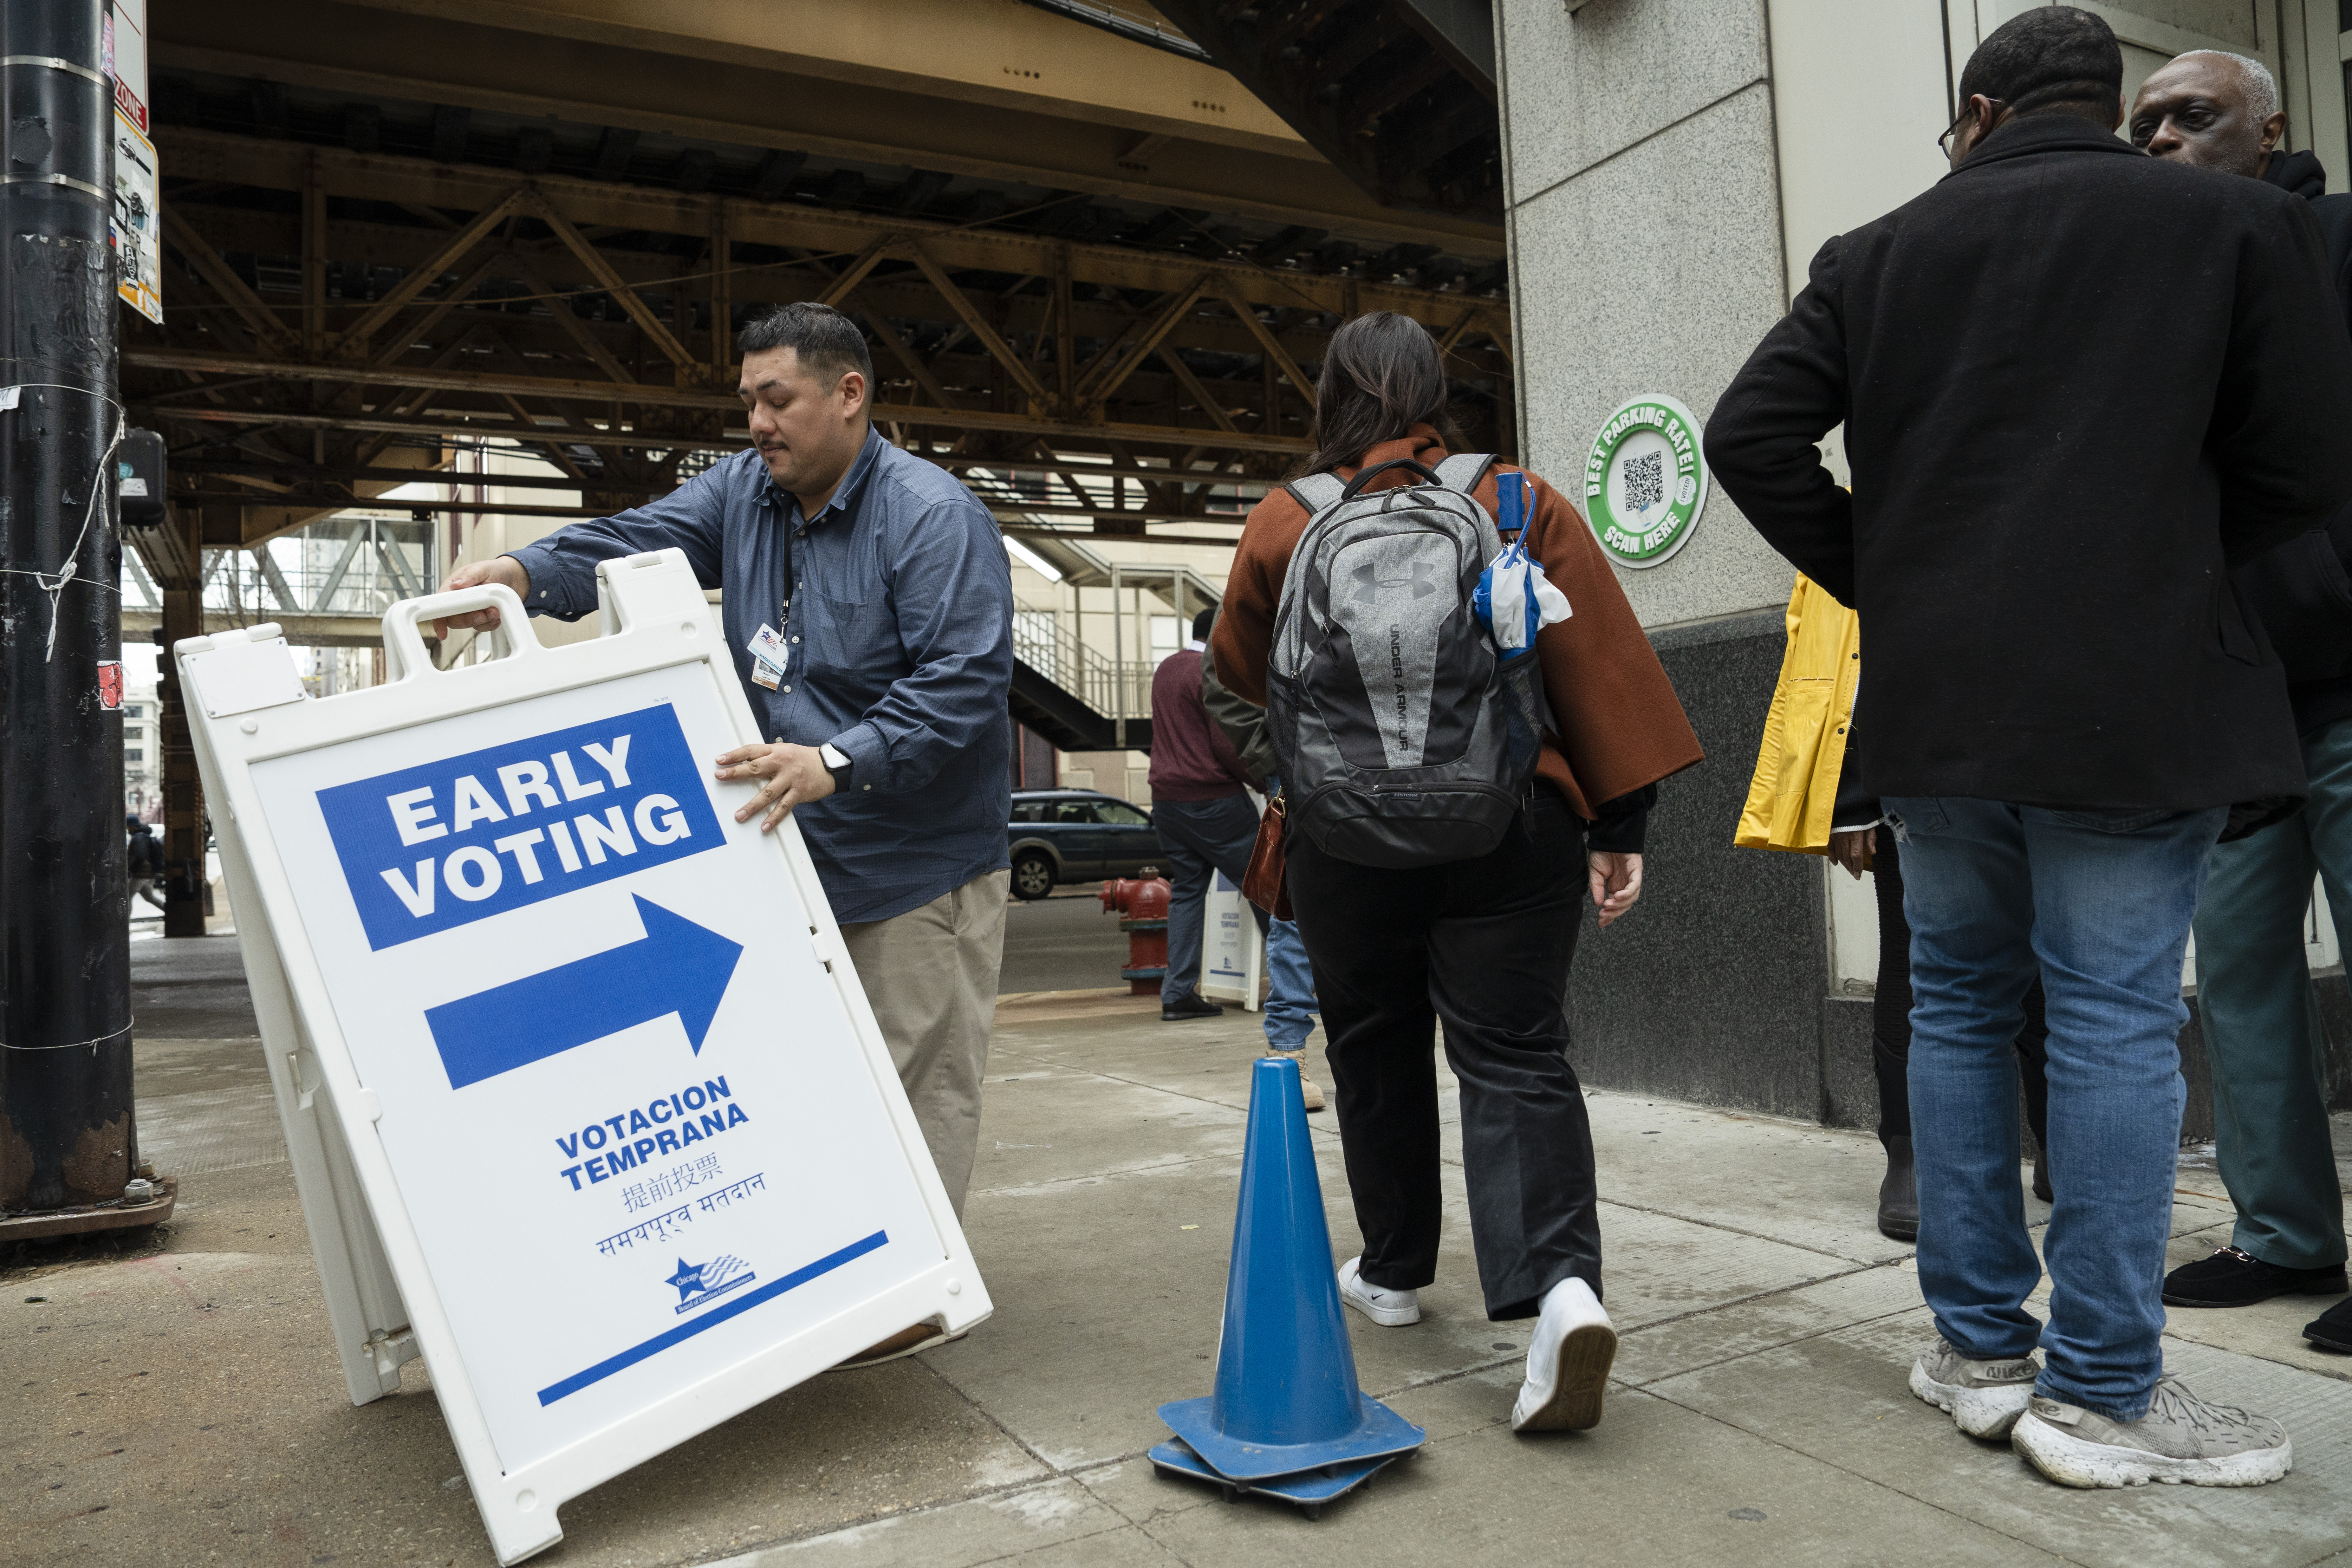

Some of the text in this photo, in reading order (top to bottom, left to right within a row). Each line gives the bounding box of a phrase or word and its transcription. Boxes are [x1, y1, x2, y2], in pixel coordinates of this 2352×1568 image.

[115, 76, 143, 125] ZONE
[1587, 407, 1694, 497] BEST PARKING RATE!
[1681, 478, 1690, 498] VOTED!
[1604, 511, 1681, 553] SCAN HERE
[759, 653, 782, 673] MARIO GARCIA
[1390, 624, 1408, 751] UNDER ARMOUR
[386, 734, 632, 847] EARLY
[379, 793, 692, 918] VOTING
[555, 1075, 732, 1159] VOTACION
[560, 1102, 750, 1191] TEMPRANA
[621, 1152, 723, 1213] 提前投票
[697, 1172, 766, 1212] मतदान
[676, 1272, 699, 1286] Chicago
[678, 1302, 694, 1313] Board
[699, 1290, 719, 1302] Election
[719, 1274, 753, 1295] Commissioners
